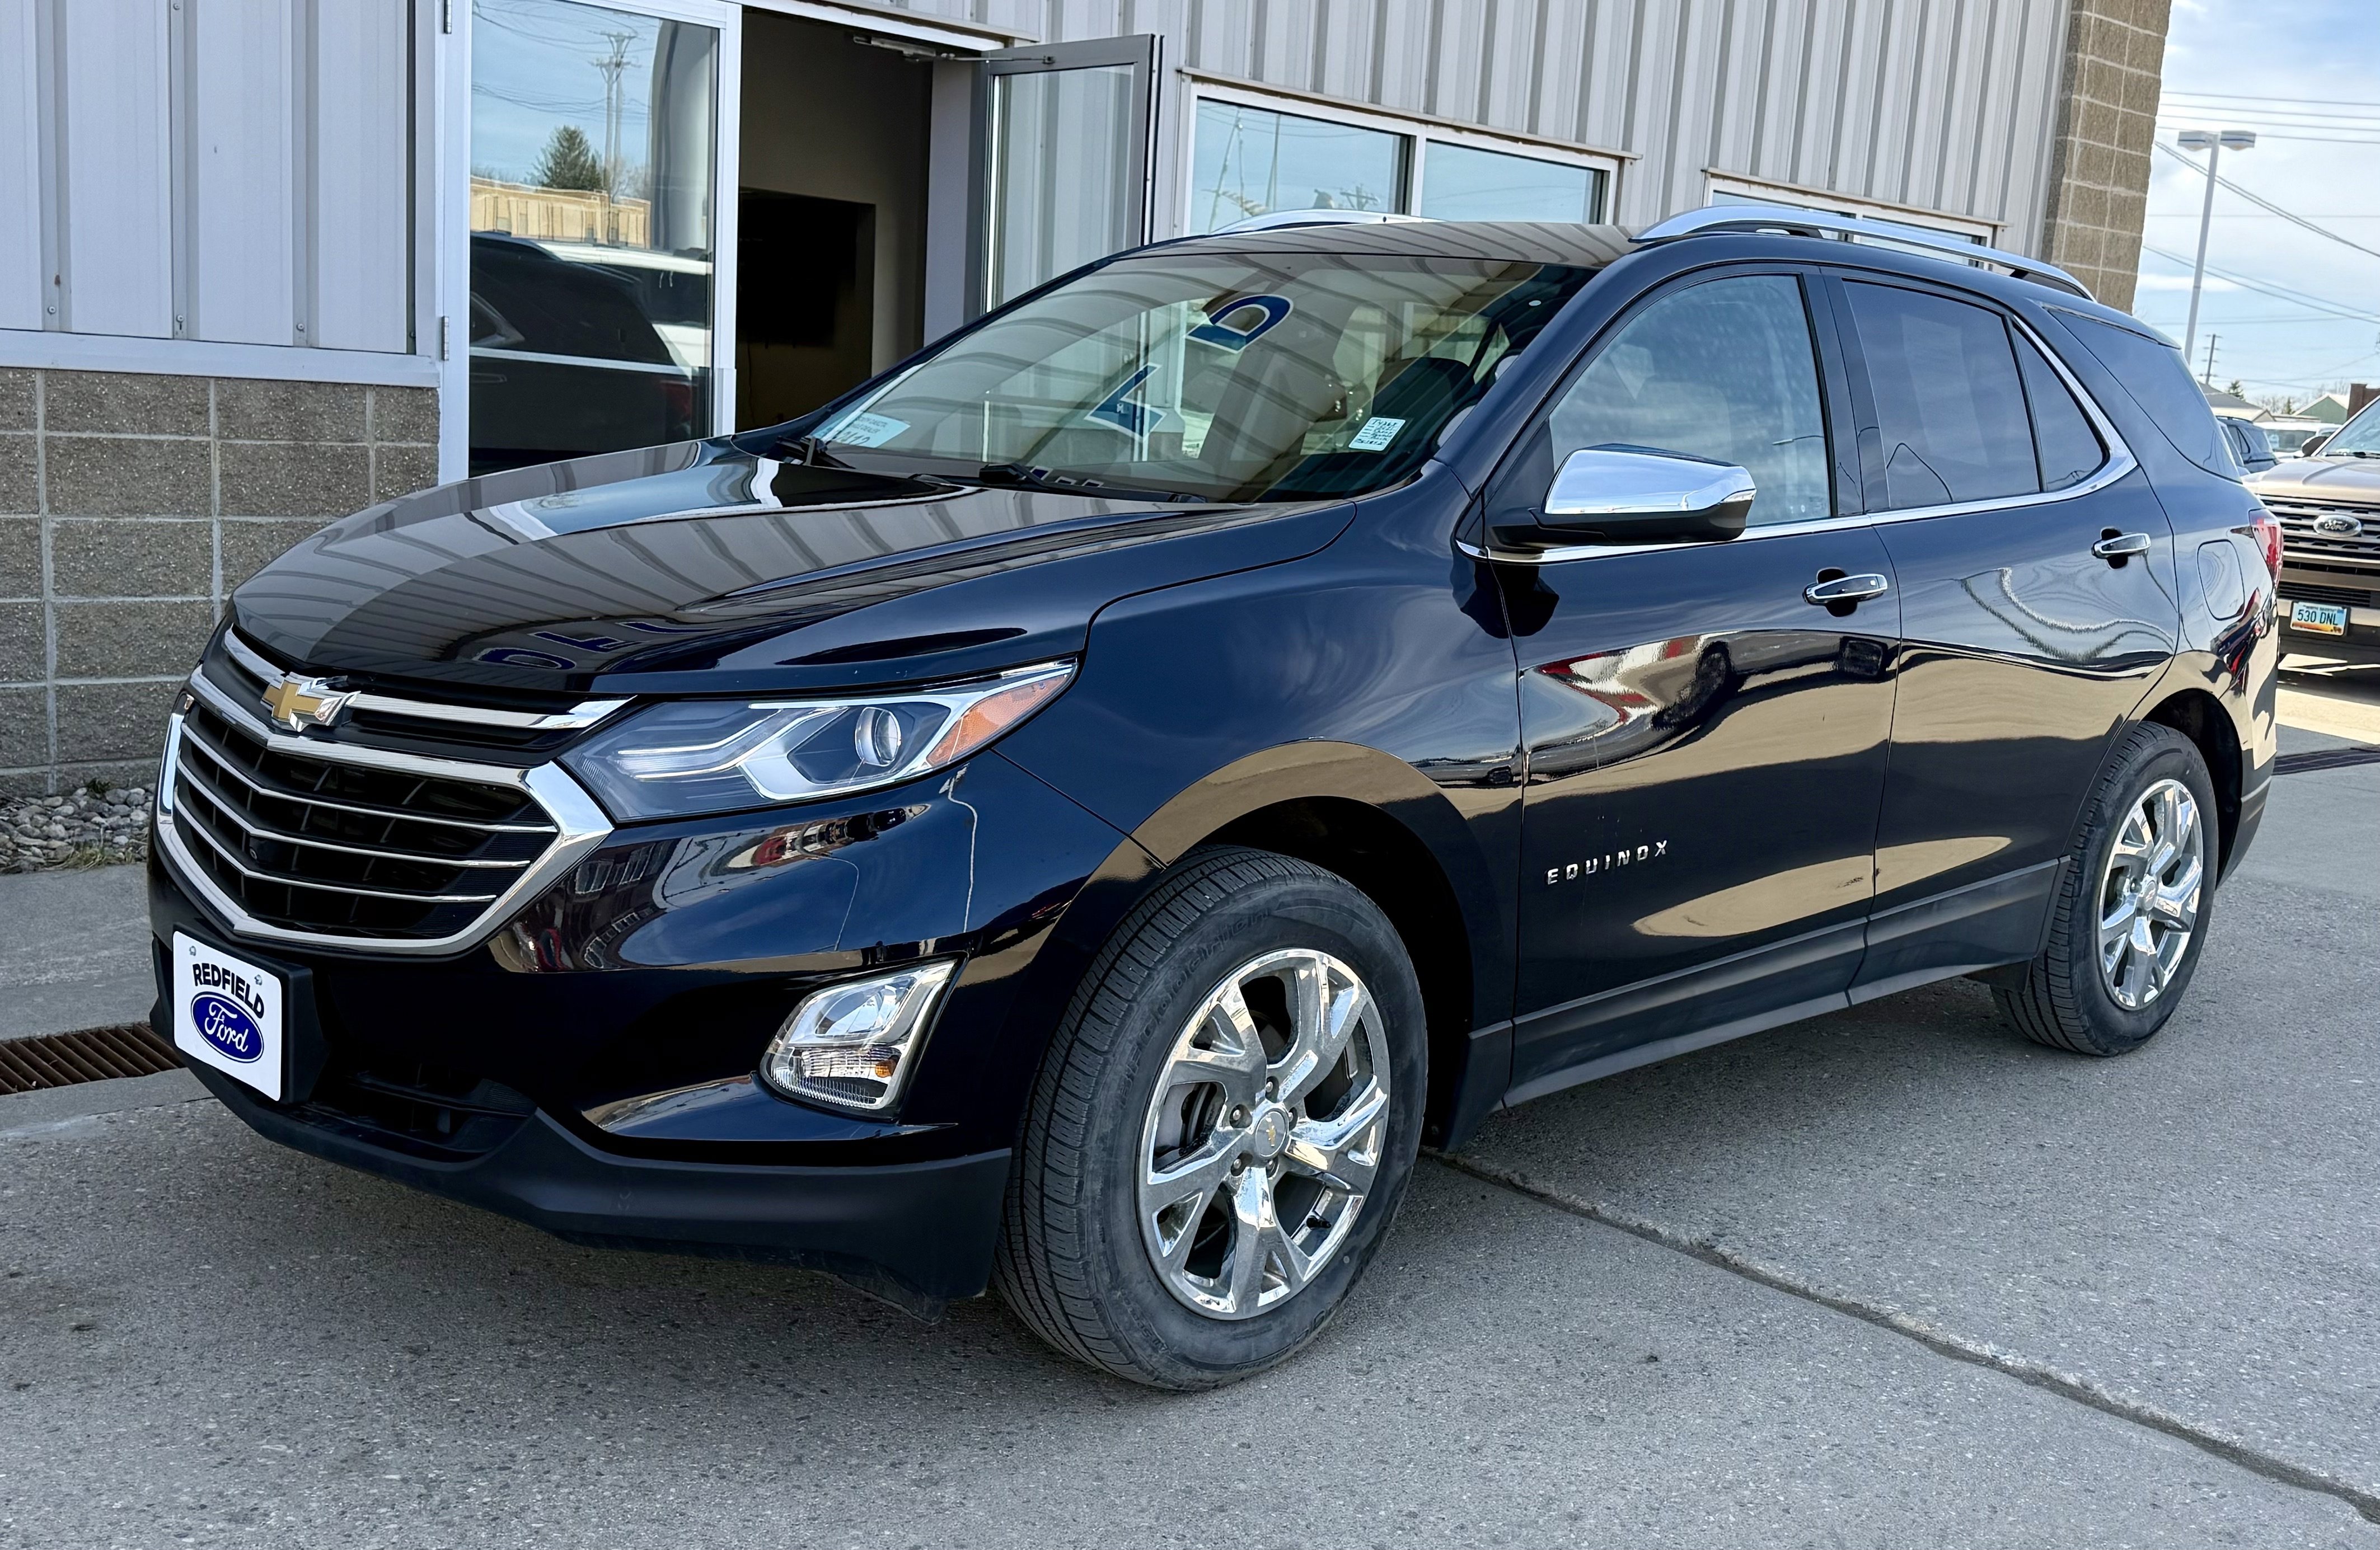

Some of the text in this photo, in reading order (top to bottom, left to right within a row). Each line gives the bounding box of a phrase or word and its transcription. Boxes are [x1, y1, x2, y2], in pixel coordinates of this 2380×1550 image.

[2324, 519, 2348, 531] Ford
[2297, 609, 2338, 626] 530 DNL
[1547, 840, 1667, 885] EQUINOX
[192, 962, 264, 1019] REDFIELD
[204, 1001, 249, 1052] Ford
